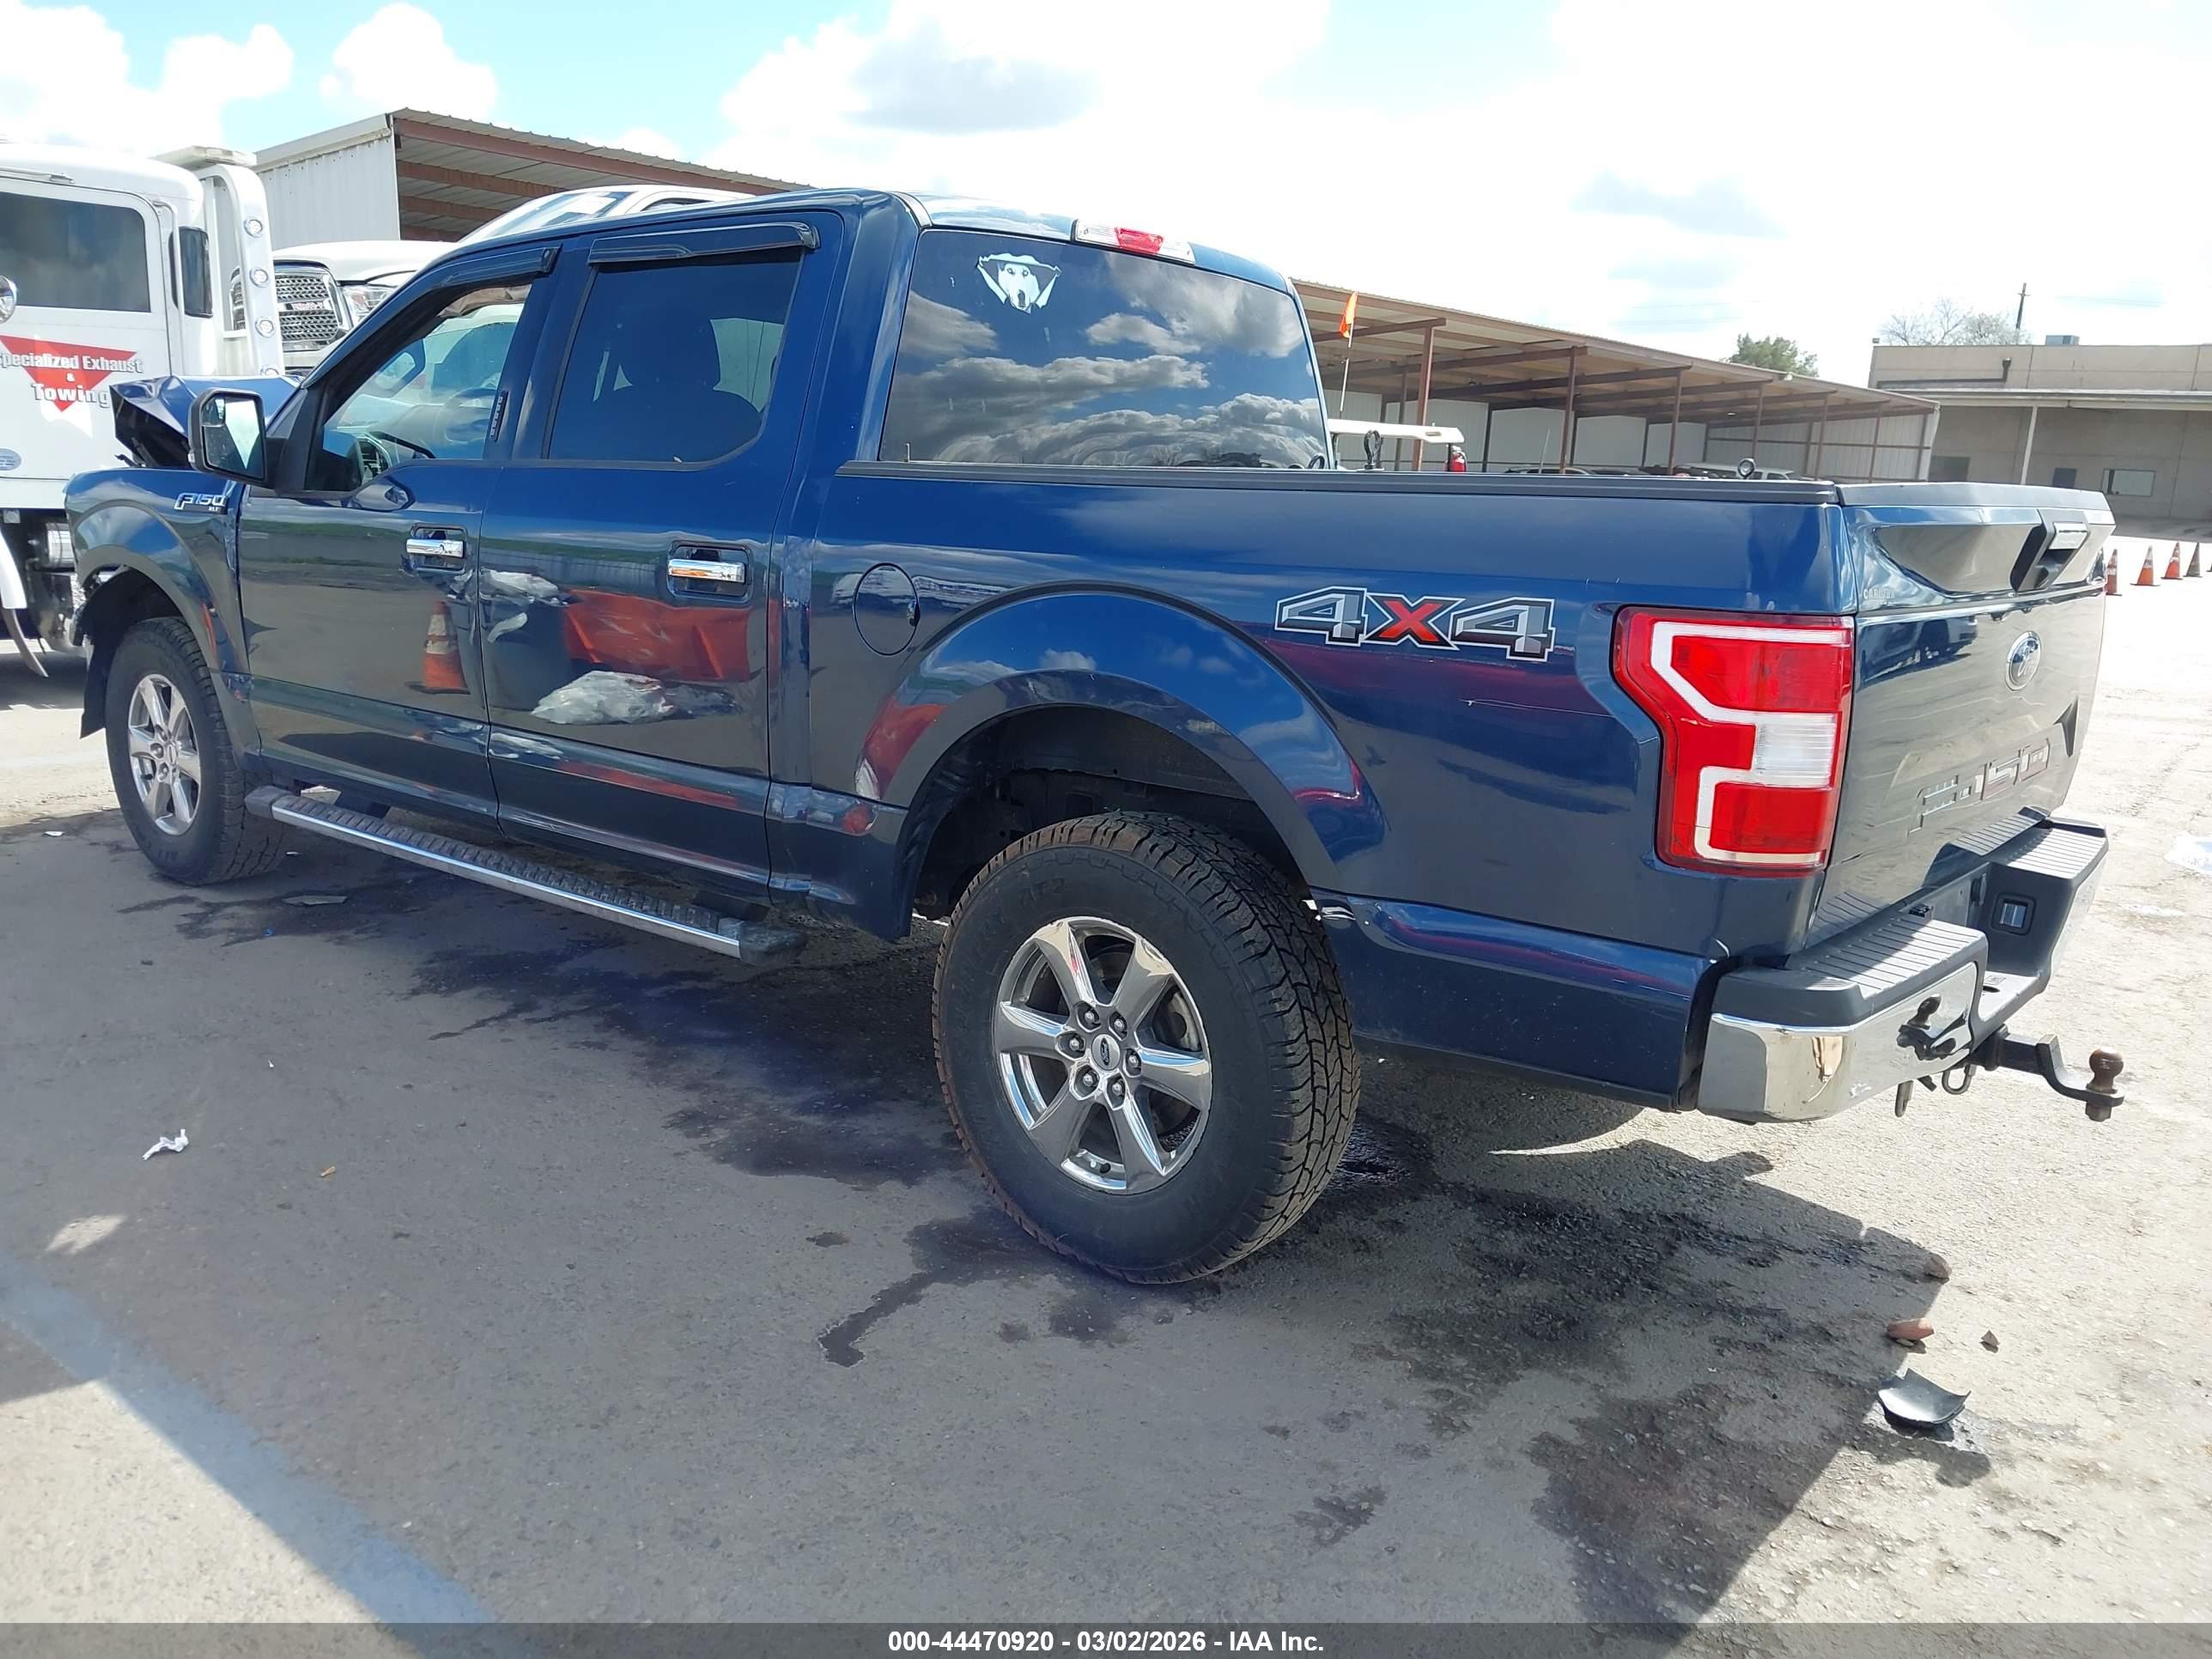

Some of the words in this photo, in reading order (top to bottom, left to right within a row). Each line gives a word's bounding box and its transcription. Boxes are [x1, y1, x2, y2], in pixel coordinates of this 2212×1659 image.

[82, 356, 143, 373] Exhaust
[66, 373, 76, 382] &
[31, 383, 111, 408] Towing
